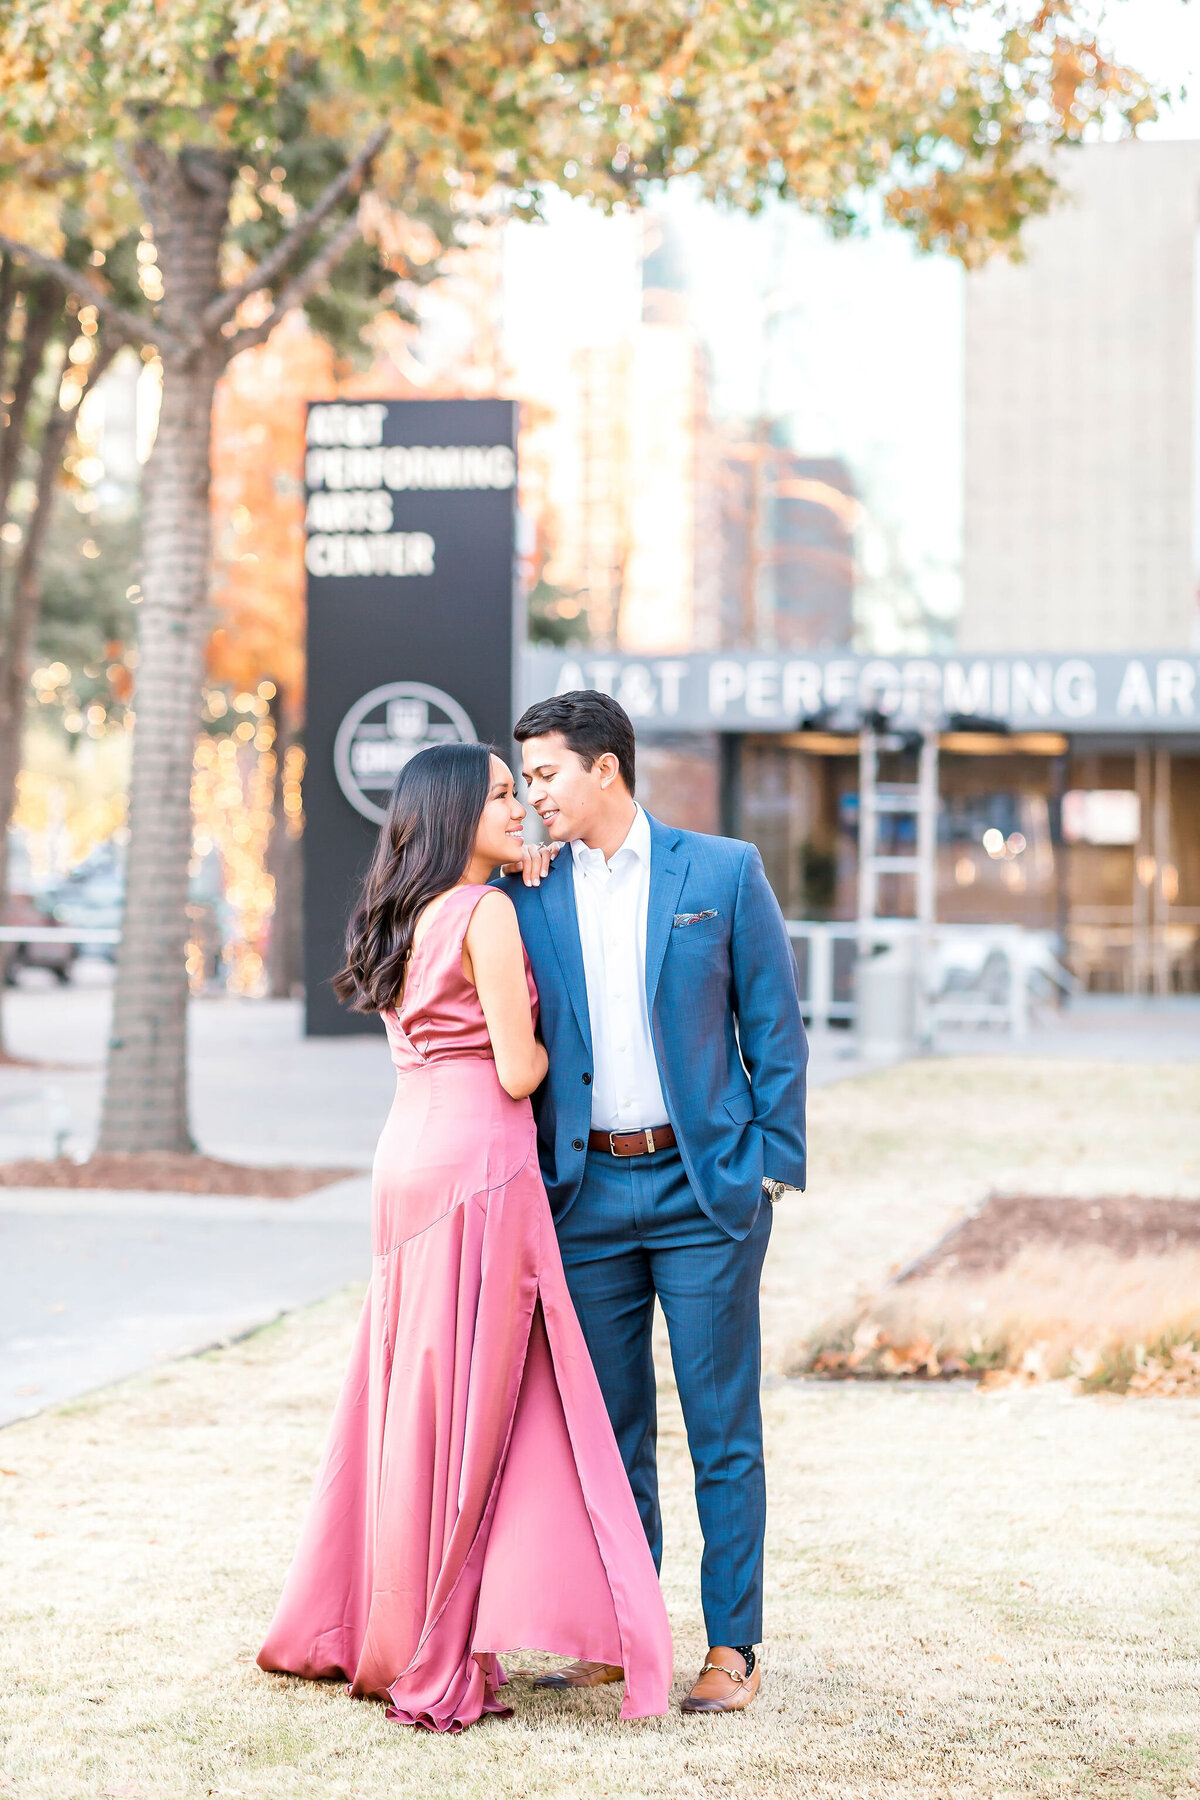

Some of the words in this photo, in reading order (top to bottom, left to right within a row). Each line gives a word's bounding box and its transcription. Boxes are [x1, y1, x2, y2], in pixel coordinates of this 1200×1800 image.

[306, 533, 435, 577] CENTER
[555, 661, 688, 717] AT&T
[709, 660, 1097, 717] PERFORMING
[1116, 660, 1200, 717] AR
